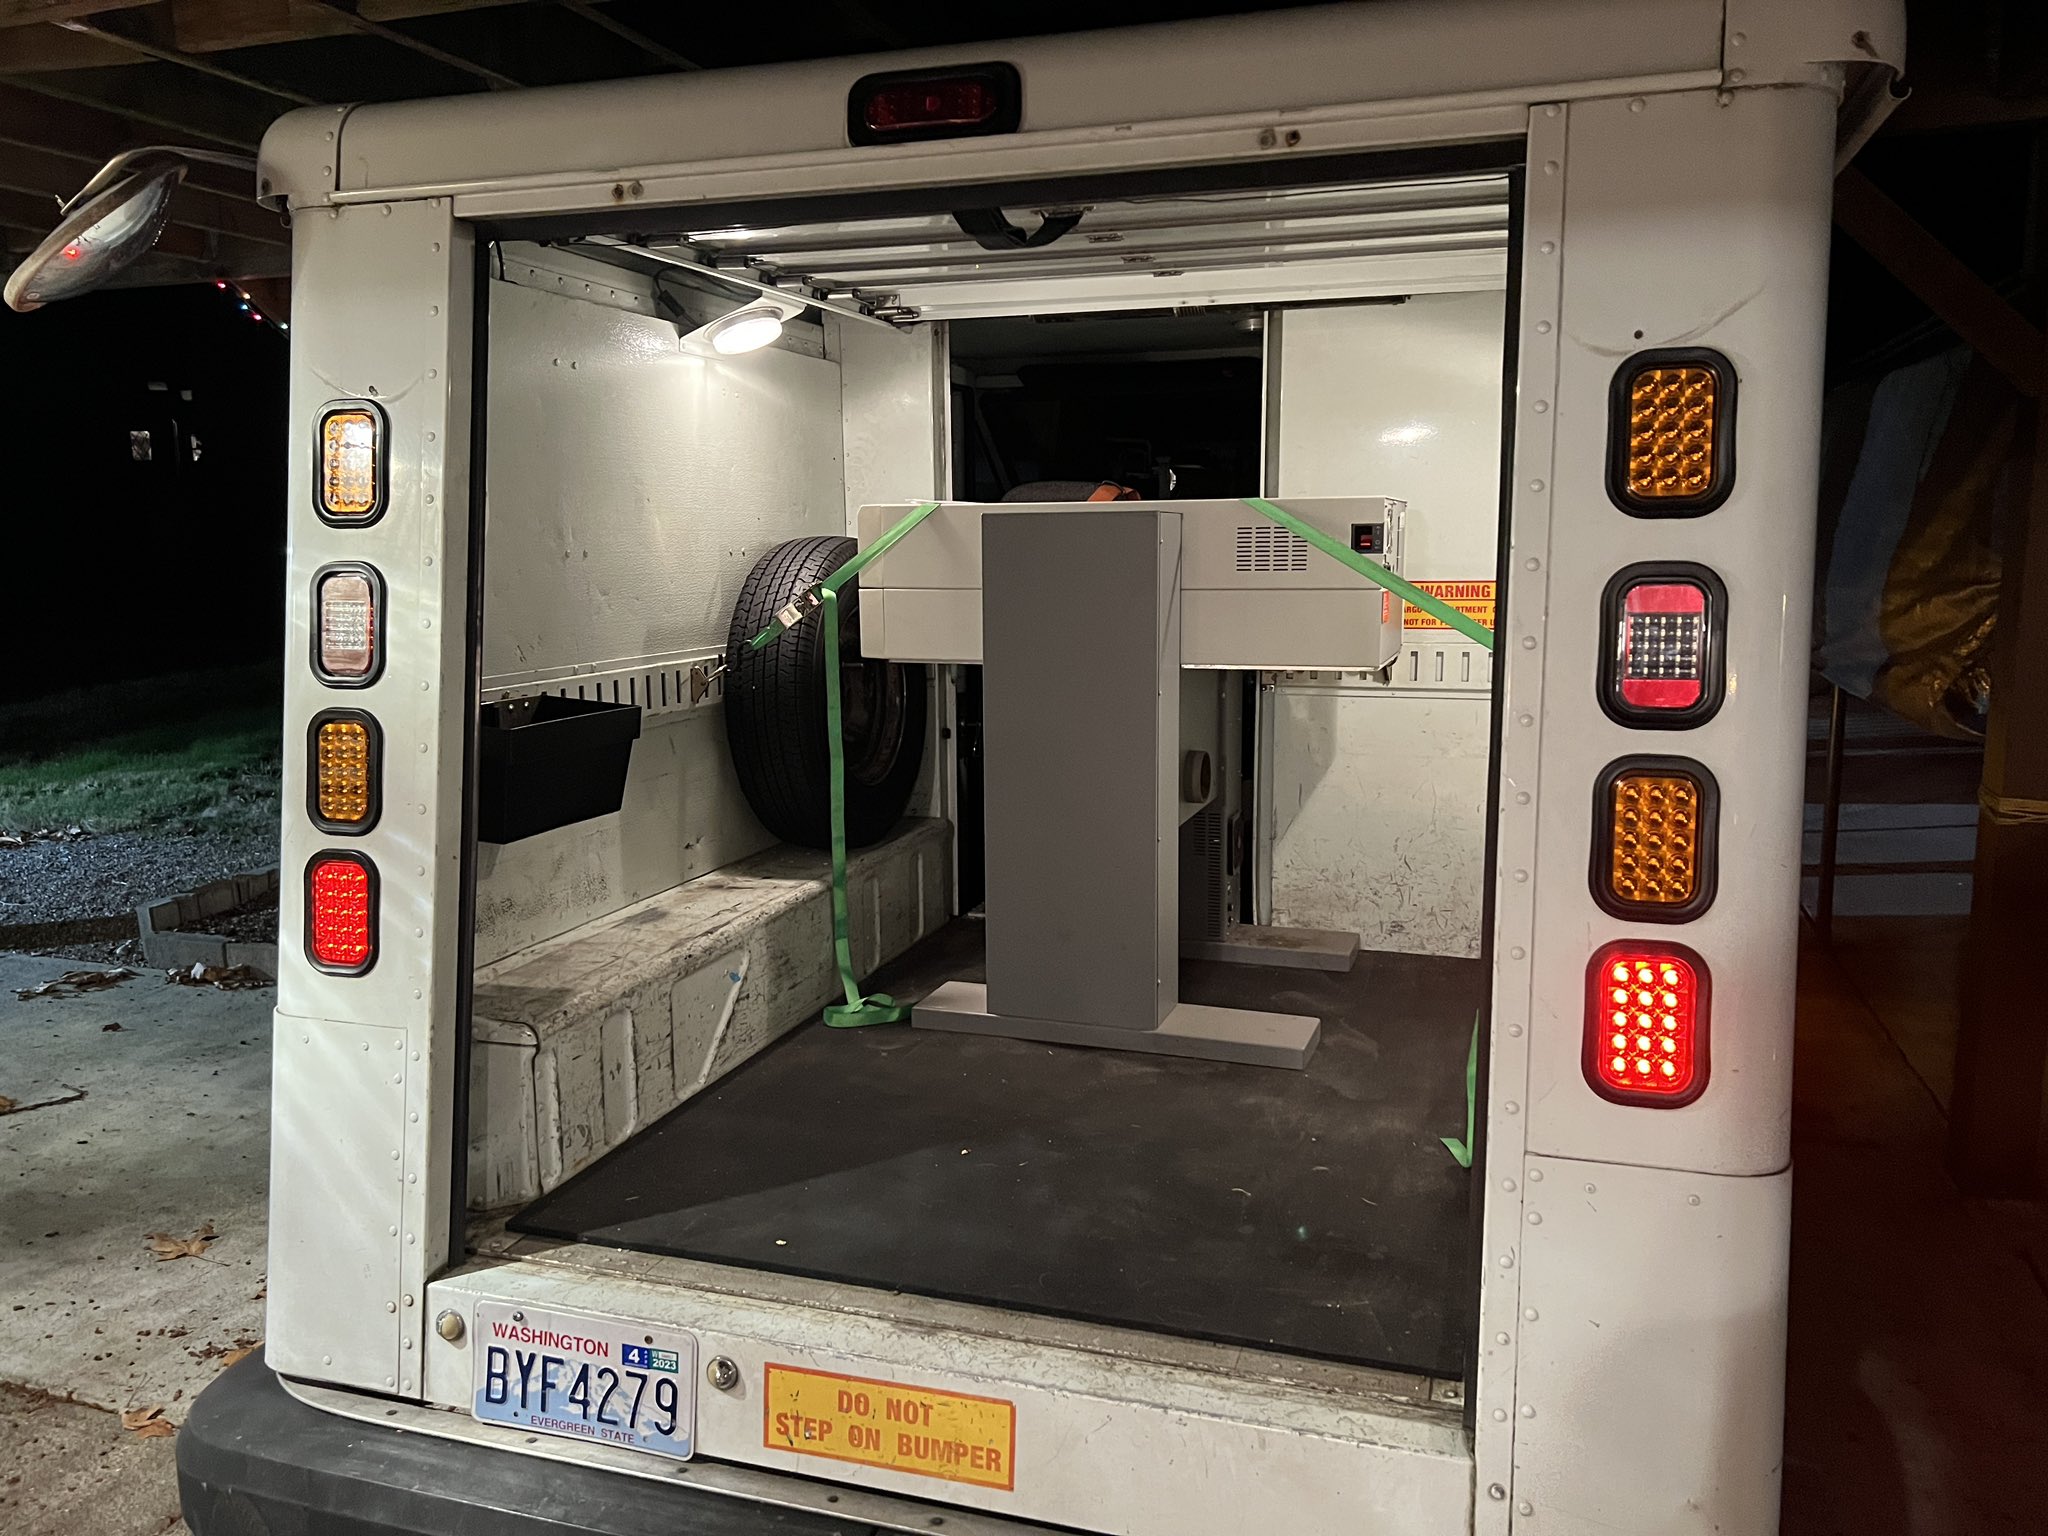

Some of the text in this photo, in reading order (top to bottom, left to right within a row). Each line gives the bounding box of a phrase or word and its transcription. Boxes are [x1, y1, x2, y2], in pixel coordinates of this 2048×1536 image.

[1420, 584, 1491, 598] WARNING
[492, 1322, 609, 1357] WASHINGTON
[628, 1348, 640, 1364] 4
[652, 1358, 677, 1370] 2023
[485, 1345, 679, 1436] BYF4279
[837, 1389, 934, 1427] DO NOT
[531, 1415, 635, 1444] EVERGREEN STATE
[775, 1412, 1001, 1473] STEP ON BUMPER
